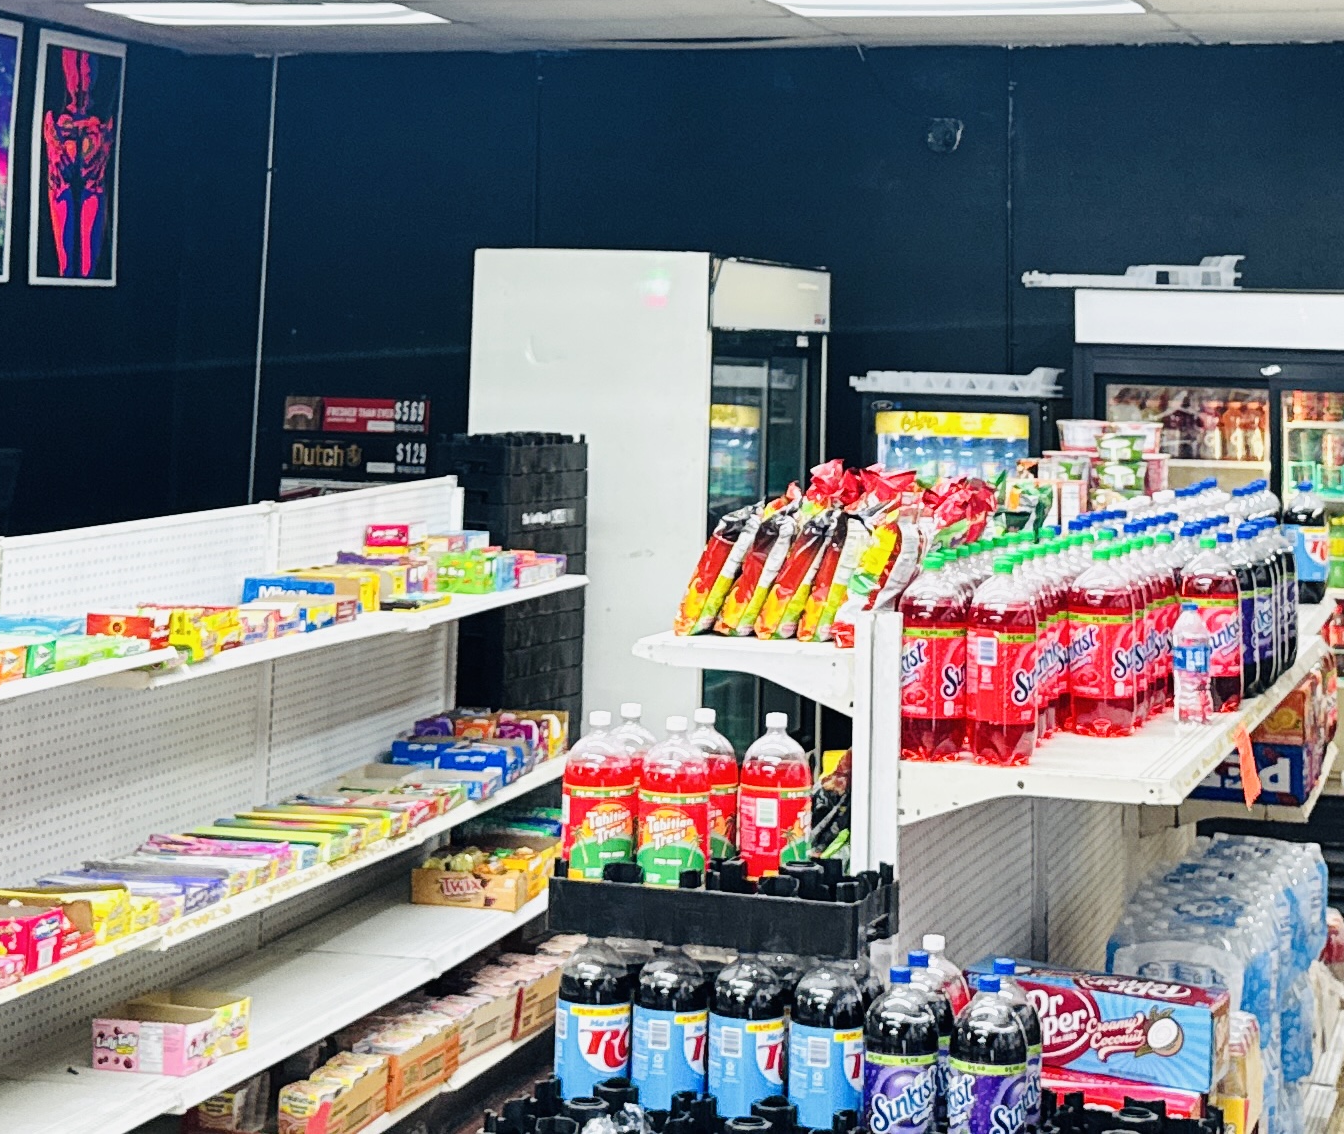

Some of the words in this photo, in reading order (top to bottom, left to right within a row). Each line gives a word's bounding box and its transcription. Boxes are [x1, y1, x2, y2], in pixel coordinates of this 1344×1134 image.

[292, 443, 344, 466] Dutch
[646, 814, 694, 834] Tahitian
[1032, 990, 1064, 1017] Dr
[1086, 1011, 1144, 1033] Creamy
[581, 1028, 630, 1068] RC
[1090, 1030, 1145, 1054] Coconut
